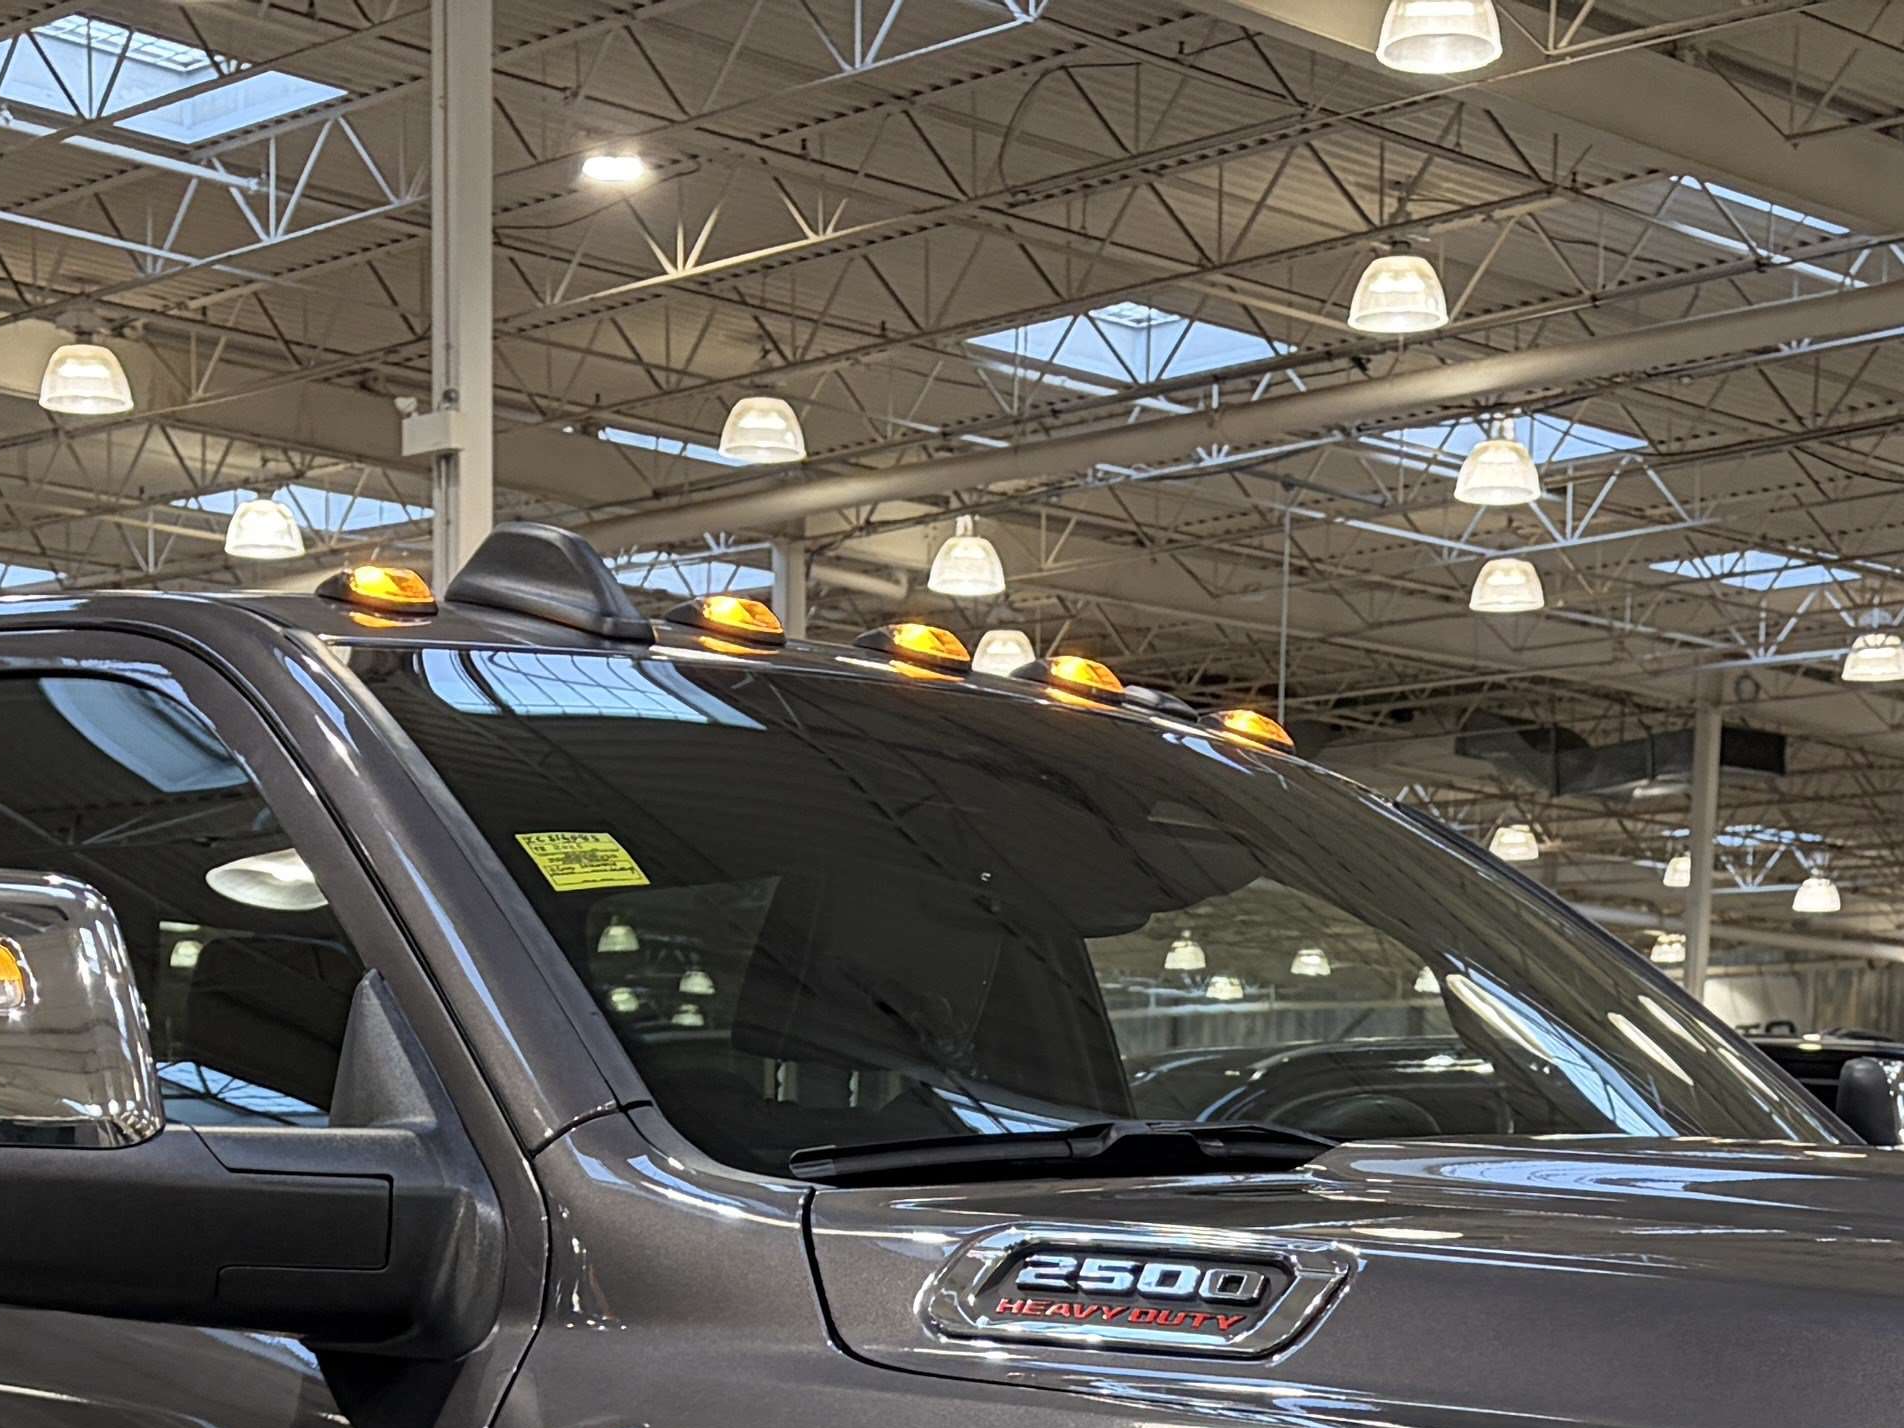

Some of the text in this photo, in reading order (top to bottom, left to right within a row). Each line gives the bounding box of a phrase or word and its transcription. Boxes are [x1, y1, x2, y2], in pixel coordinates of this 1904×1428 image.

[1014, 1253, 1270, 1304] 2500
[996, 1297, 1247, 1331] HEAVY DUTY
